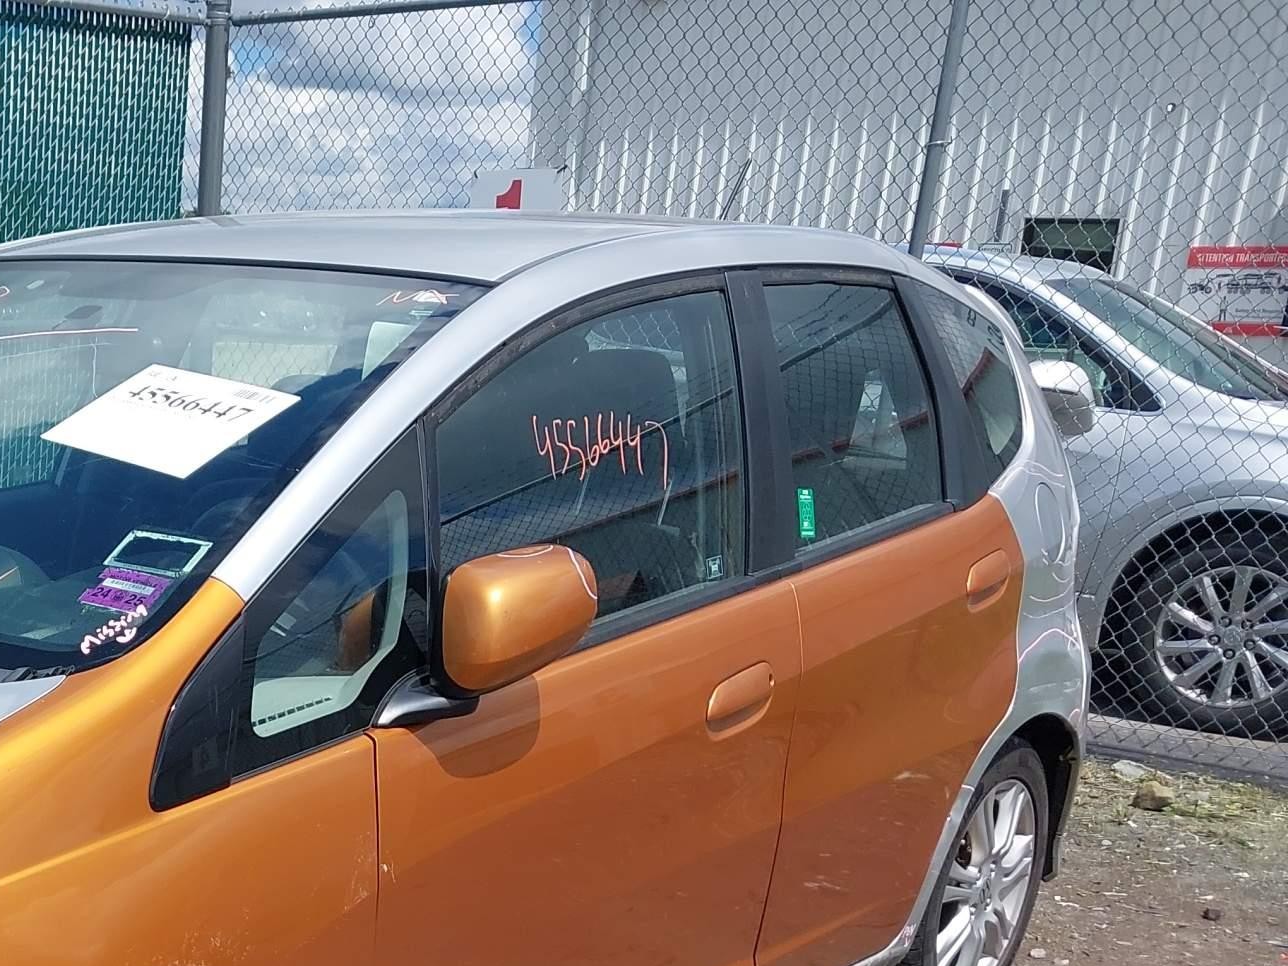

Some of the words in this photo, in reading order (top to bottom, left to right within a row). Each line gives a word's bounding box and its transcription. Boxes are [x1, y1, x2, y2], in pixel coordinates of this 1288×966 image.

[128, 385, 254, 422] 45566447
[532, 410, 668, 490] 45566447
[90, 587, 113, 599] 24
[124, 593, 147, 606] 25
